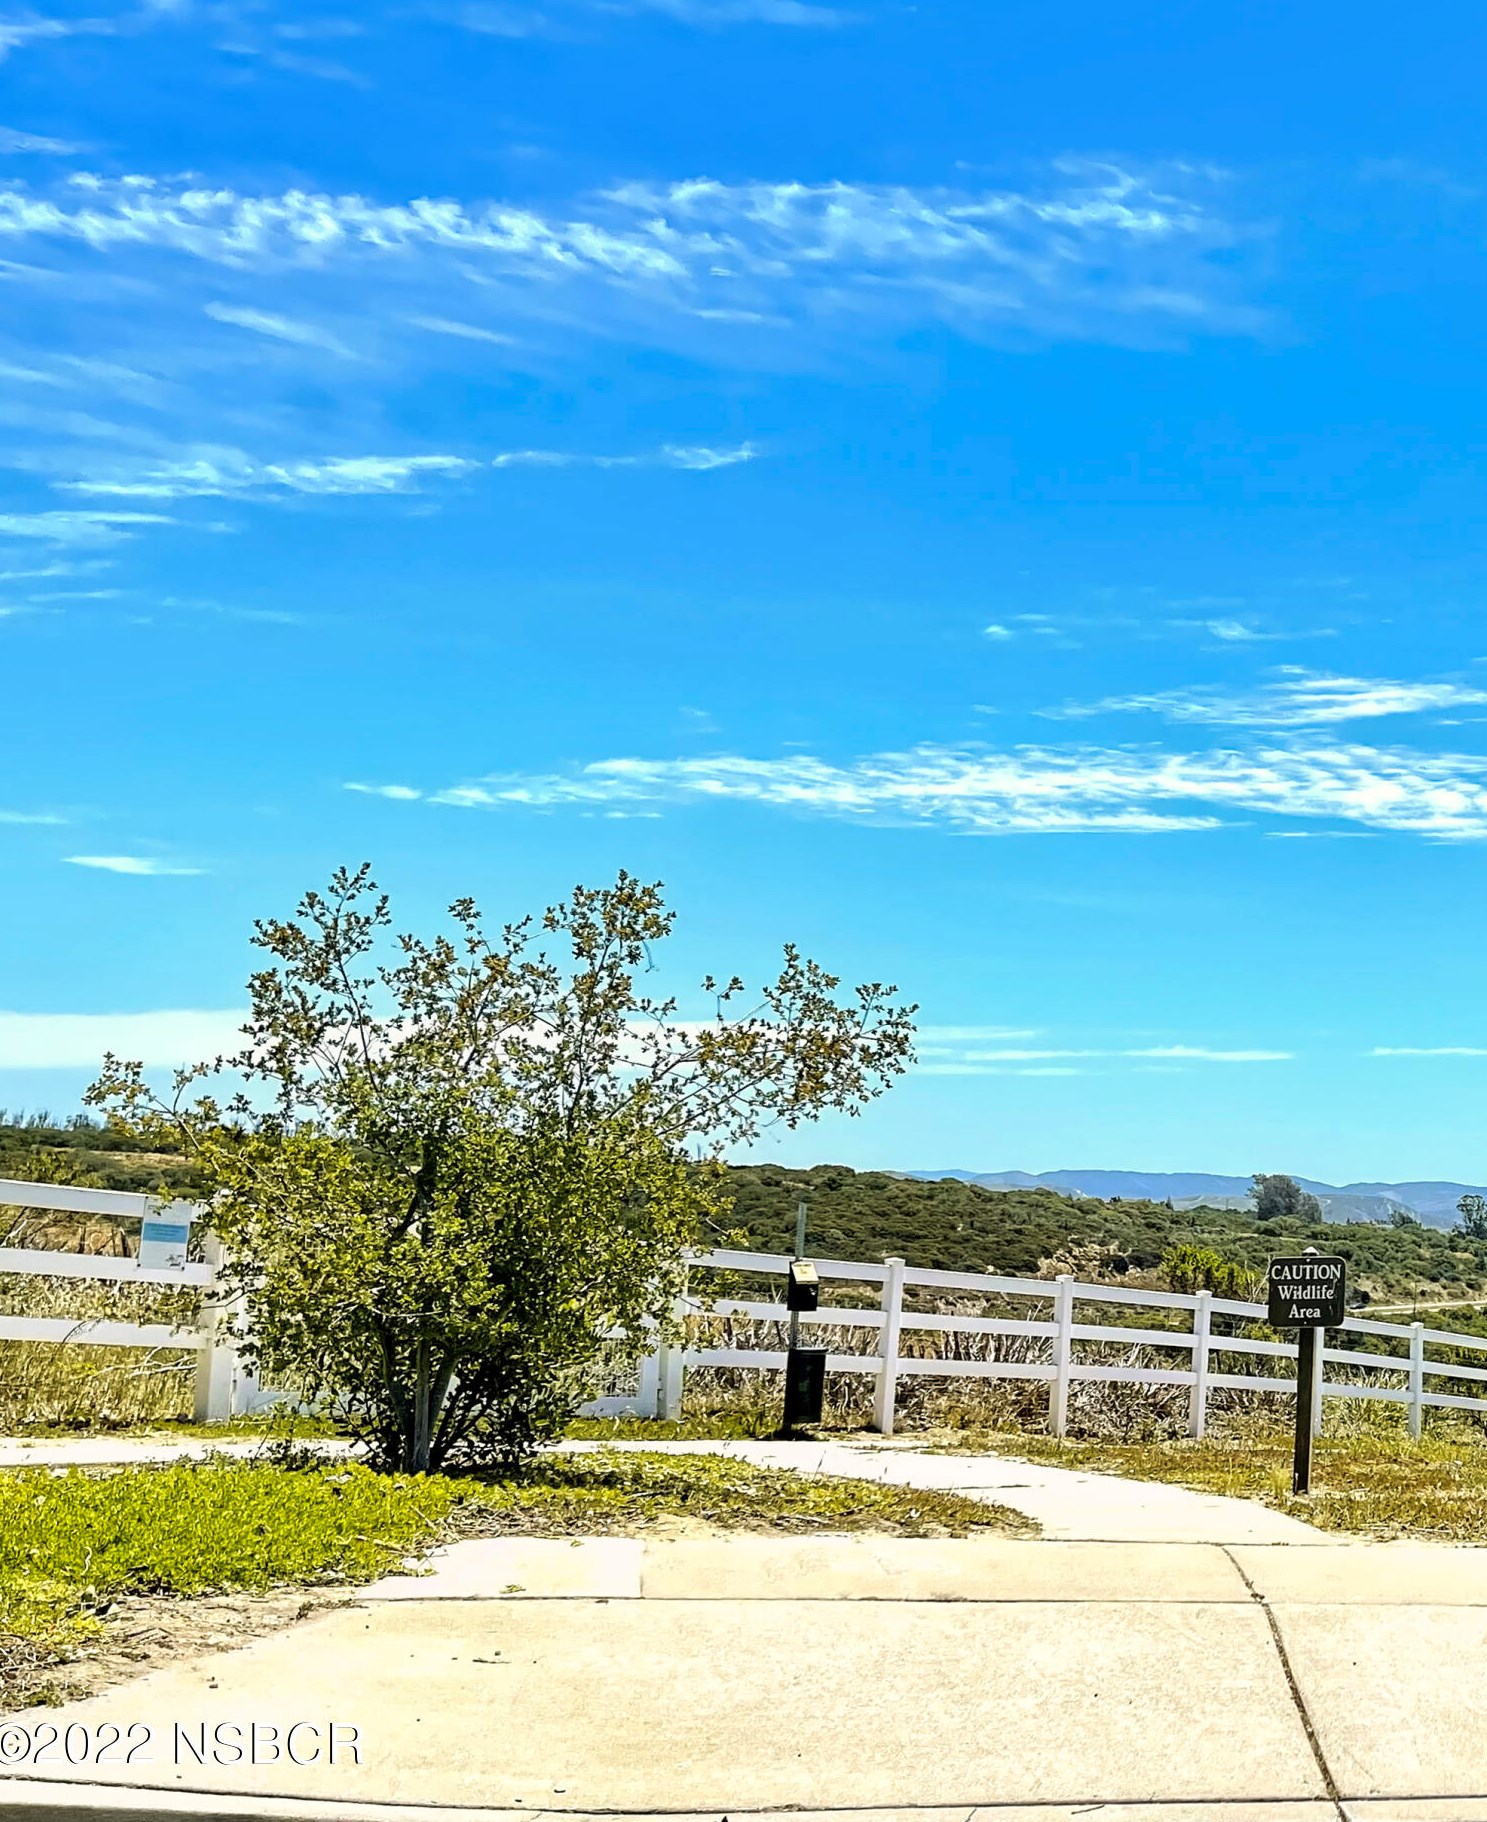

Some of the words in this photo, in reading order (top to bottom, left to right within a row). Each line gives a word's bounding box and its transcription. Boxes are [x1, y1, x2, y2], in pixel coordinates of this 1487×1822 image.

[1271, 1264, 1342, 1280] CAUTION
[1277, 1285, 1334, 1300] Wildlife
[1288, 1303, 1321, 1319] Area
